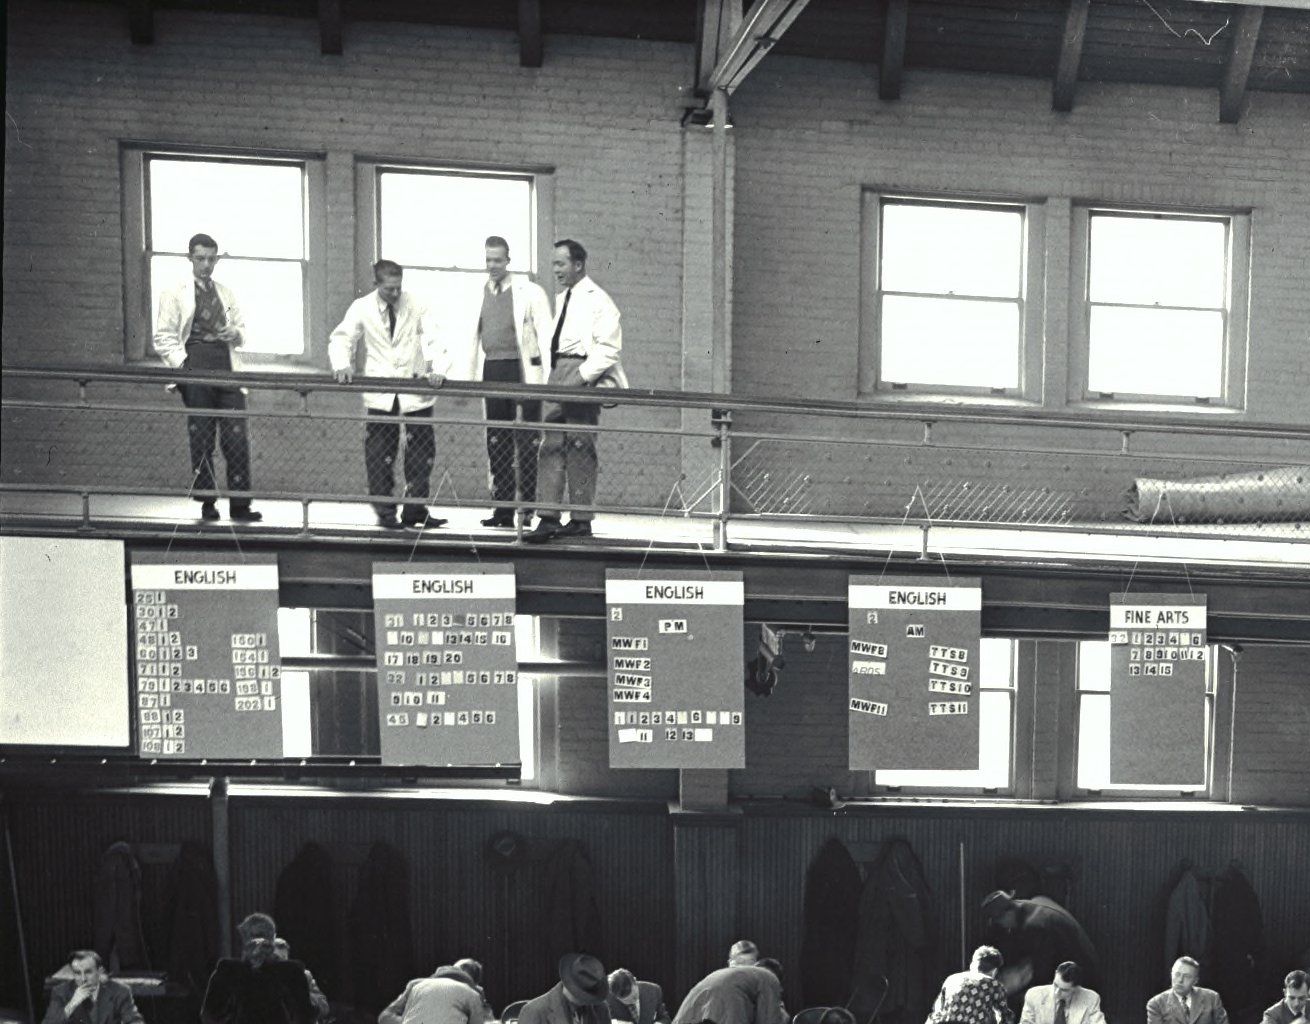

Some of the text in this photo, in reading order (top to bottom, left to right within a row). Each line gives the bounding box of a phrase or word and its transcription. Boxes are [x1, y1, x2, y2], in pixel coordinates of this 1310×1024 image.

[174, 571, 237, 584] ENGLISH
[413, 580, 473, 593] ENGLISH
[646, 586, 703, 599] ENGLISH
[889, 591, 946, 605] ENGLISH
[1125, 611, 1189, 624] FINE ARTS
